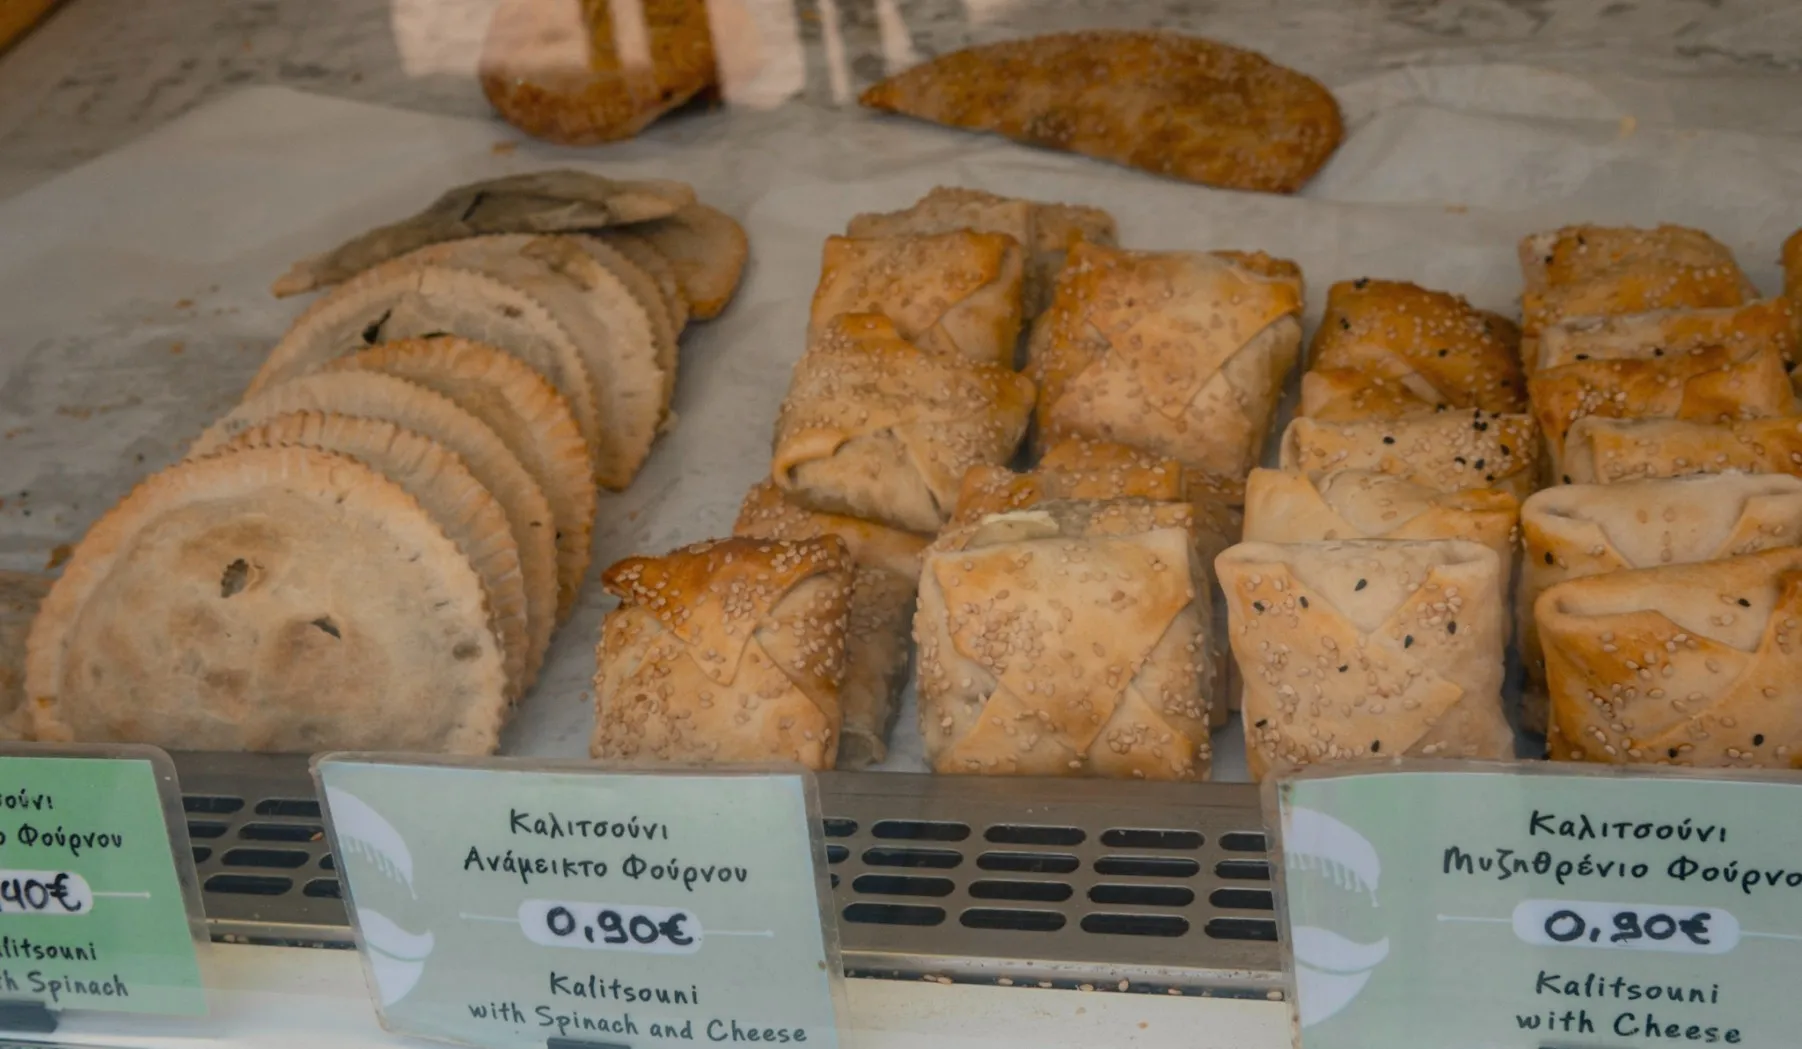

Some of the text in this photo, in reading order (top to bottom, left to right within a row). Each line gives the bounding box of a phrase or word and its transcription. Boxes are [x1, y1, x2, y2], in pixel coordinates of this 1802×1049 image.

[0, 788, 54, 810] ούνι
[17, 823, 123, 857] Φούρνου
[509, 808, 669, 841] Καλιτσούνι
[1529, 810, 1727, 843] Καλιτσούνι
[463, 846, 748, 892] Ανάμεικτο Φούρνου
[0, 873, 82, 912] 40€
[546, 905, 695, 946] 0,90€
[1544, 908, 1712, 946] 0,90€
[0, 935, 97, 960] litsouni
[0, 969, 129, 1001] h Spinach
[549, 971, 699, 1005] Kalitsouni
[1535, 970, 1719, 1004] Kalitsouni
[468, 1001, 808, 1044] with Spinach and Cheese
[1516, 1010, 1742, 1044] with Cheese
